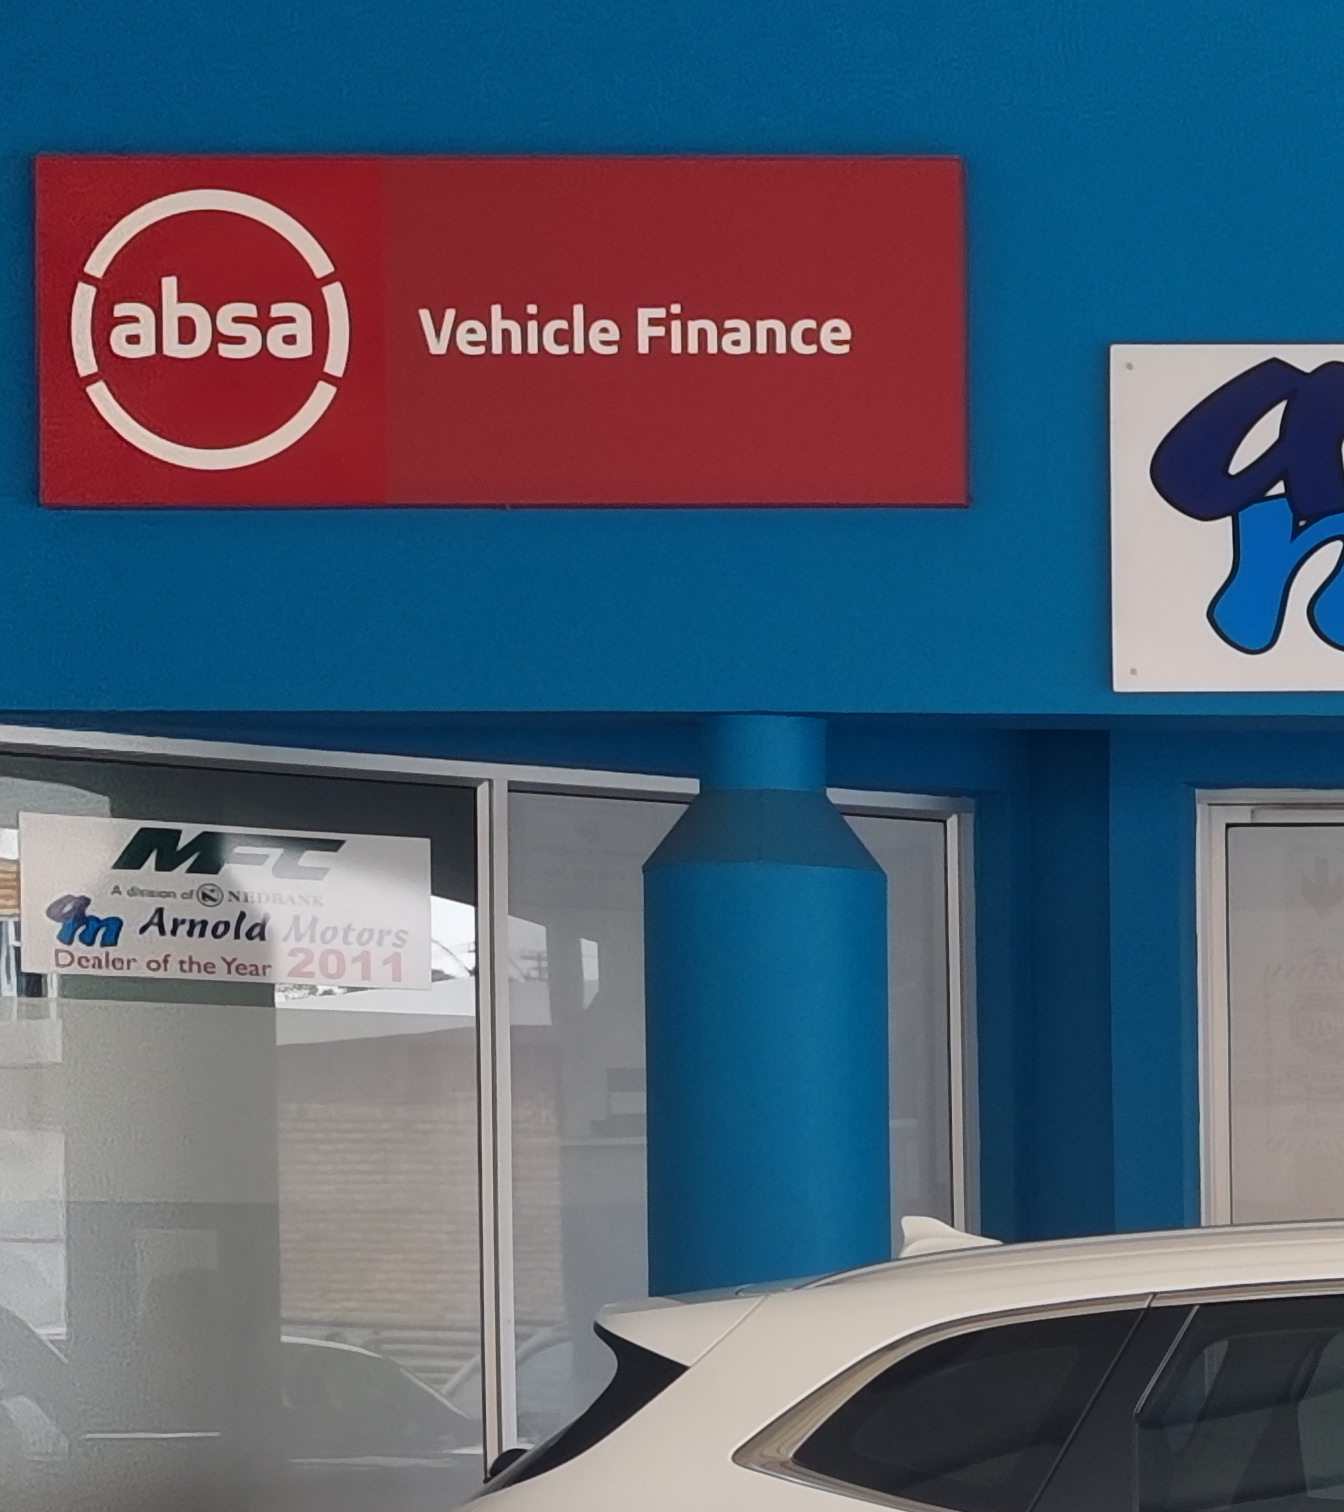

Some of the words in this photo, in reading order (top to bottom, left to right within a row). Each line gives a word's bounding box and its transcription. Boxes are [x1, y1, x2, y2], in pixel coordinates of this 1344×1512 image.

[109, 276, 313, 359] absa
[418, 304, 620, 355] Vehicle
[637, 306, 852, 355] Finance
[111, 827, 346, 881] MFC
[111, 885, 122, 896] A
[228, 890, 324, 907] NEDBANK
[139, 907, 271, 942] Arnold
[282, 914, 410, 949] Motors
[146, 953, 171, 972] of
[179, 955, 216, 974] the
[220, 956, 272, 977] Year
[287, 948, 402, 982] 2011
